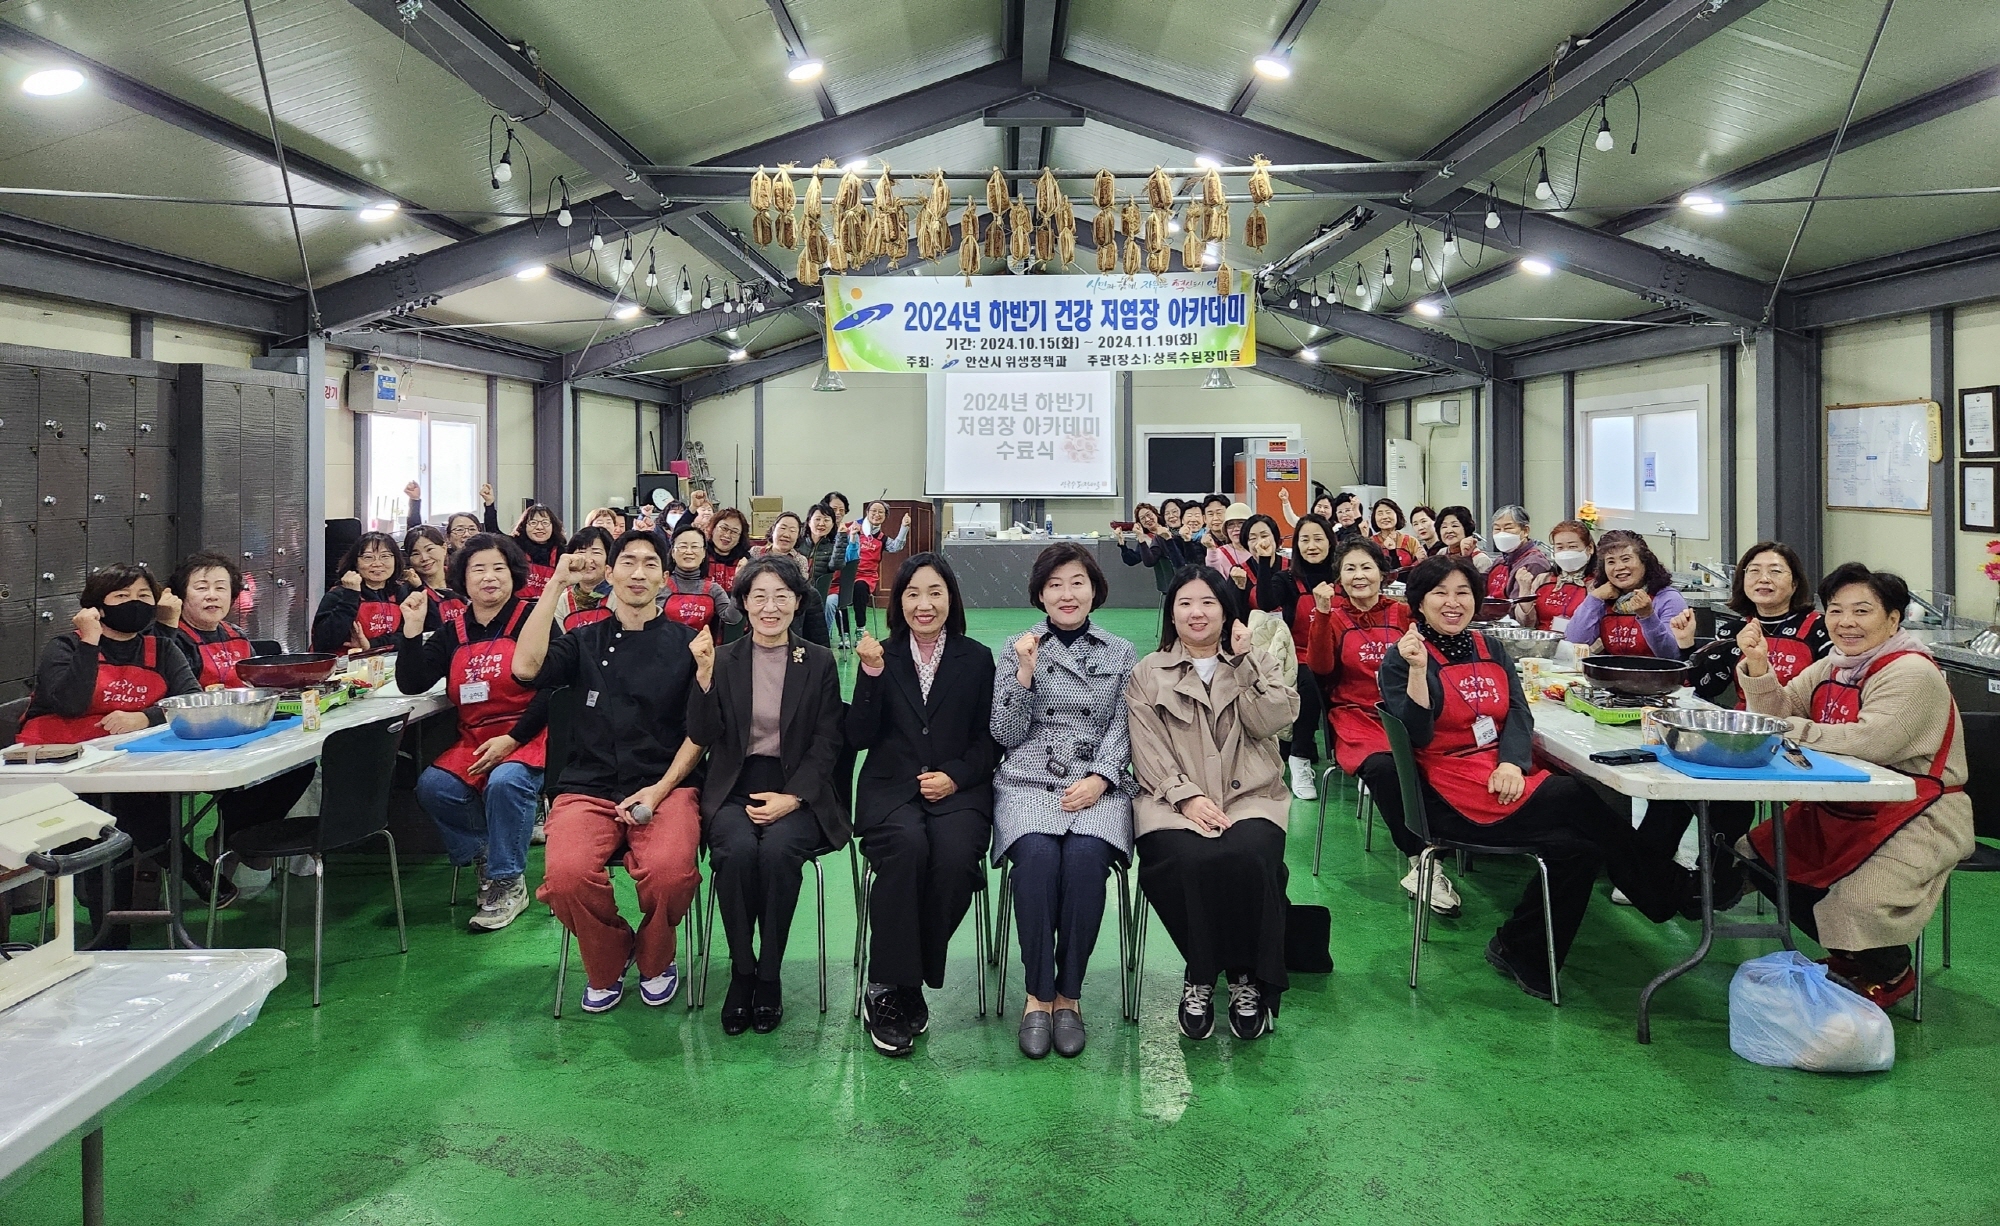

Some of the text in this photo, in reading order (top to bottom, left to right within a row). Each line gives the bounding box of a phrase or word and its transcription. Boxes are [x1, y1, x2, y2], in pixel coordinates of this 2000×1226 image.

[904, 294, 1245, 333] 2024년 하반기 건강 저염장 아카데미
[945, 337, 976, 351] 기간:
[980, 336, 1079, 350] 2024.10.15(화)
[1098, 332, 1198, 349] 2024.11.19(화)
[906, 355, 934, 369] 주최:
[965, 355, 1001, 369] 안산시
[1005, 354, 1067, 368] 위생정책과
[963, 393, 1093, 413] 2024년 하반기
[957, 416, 1100, 437] 저염장 아카데미
[996, 441, 1054, 460] 수료식
